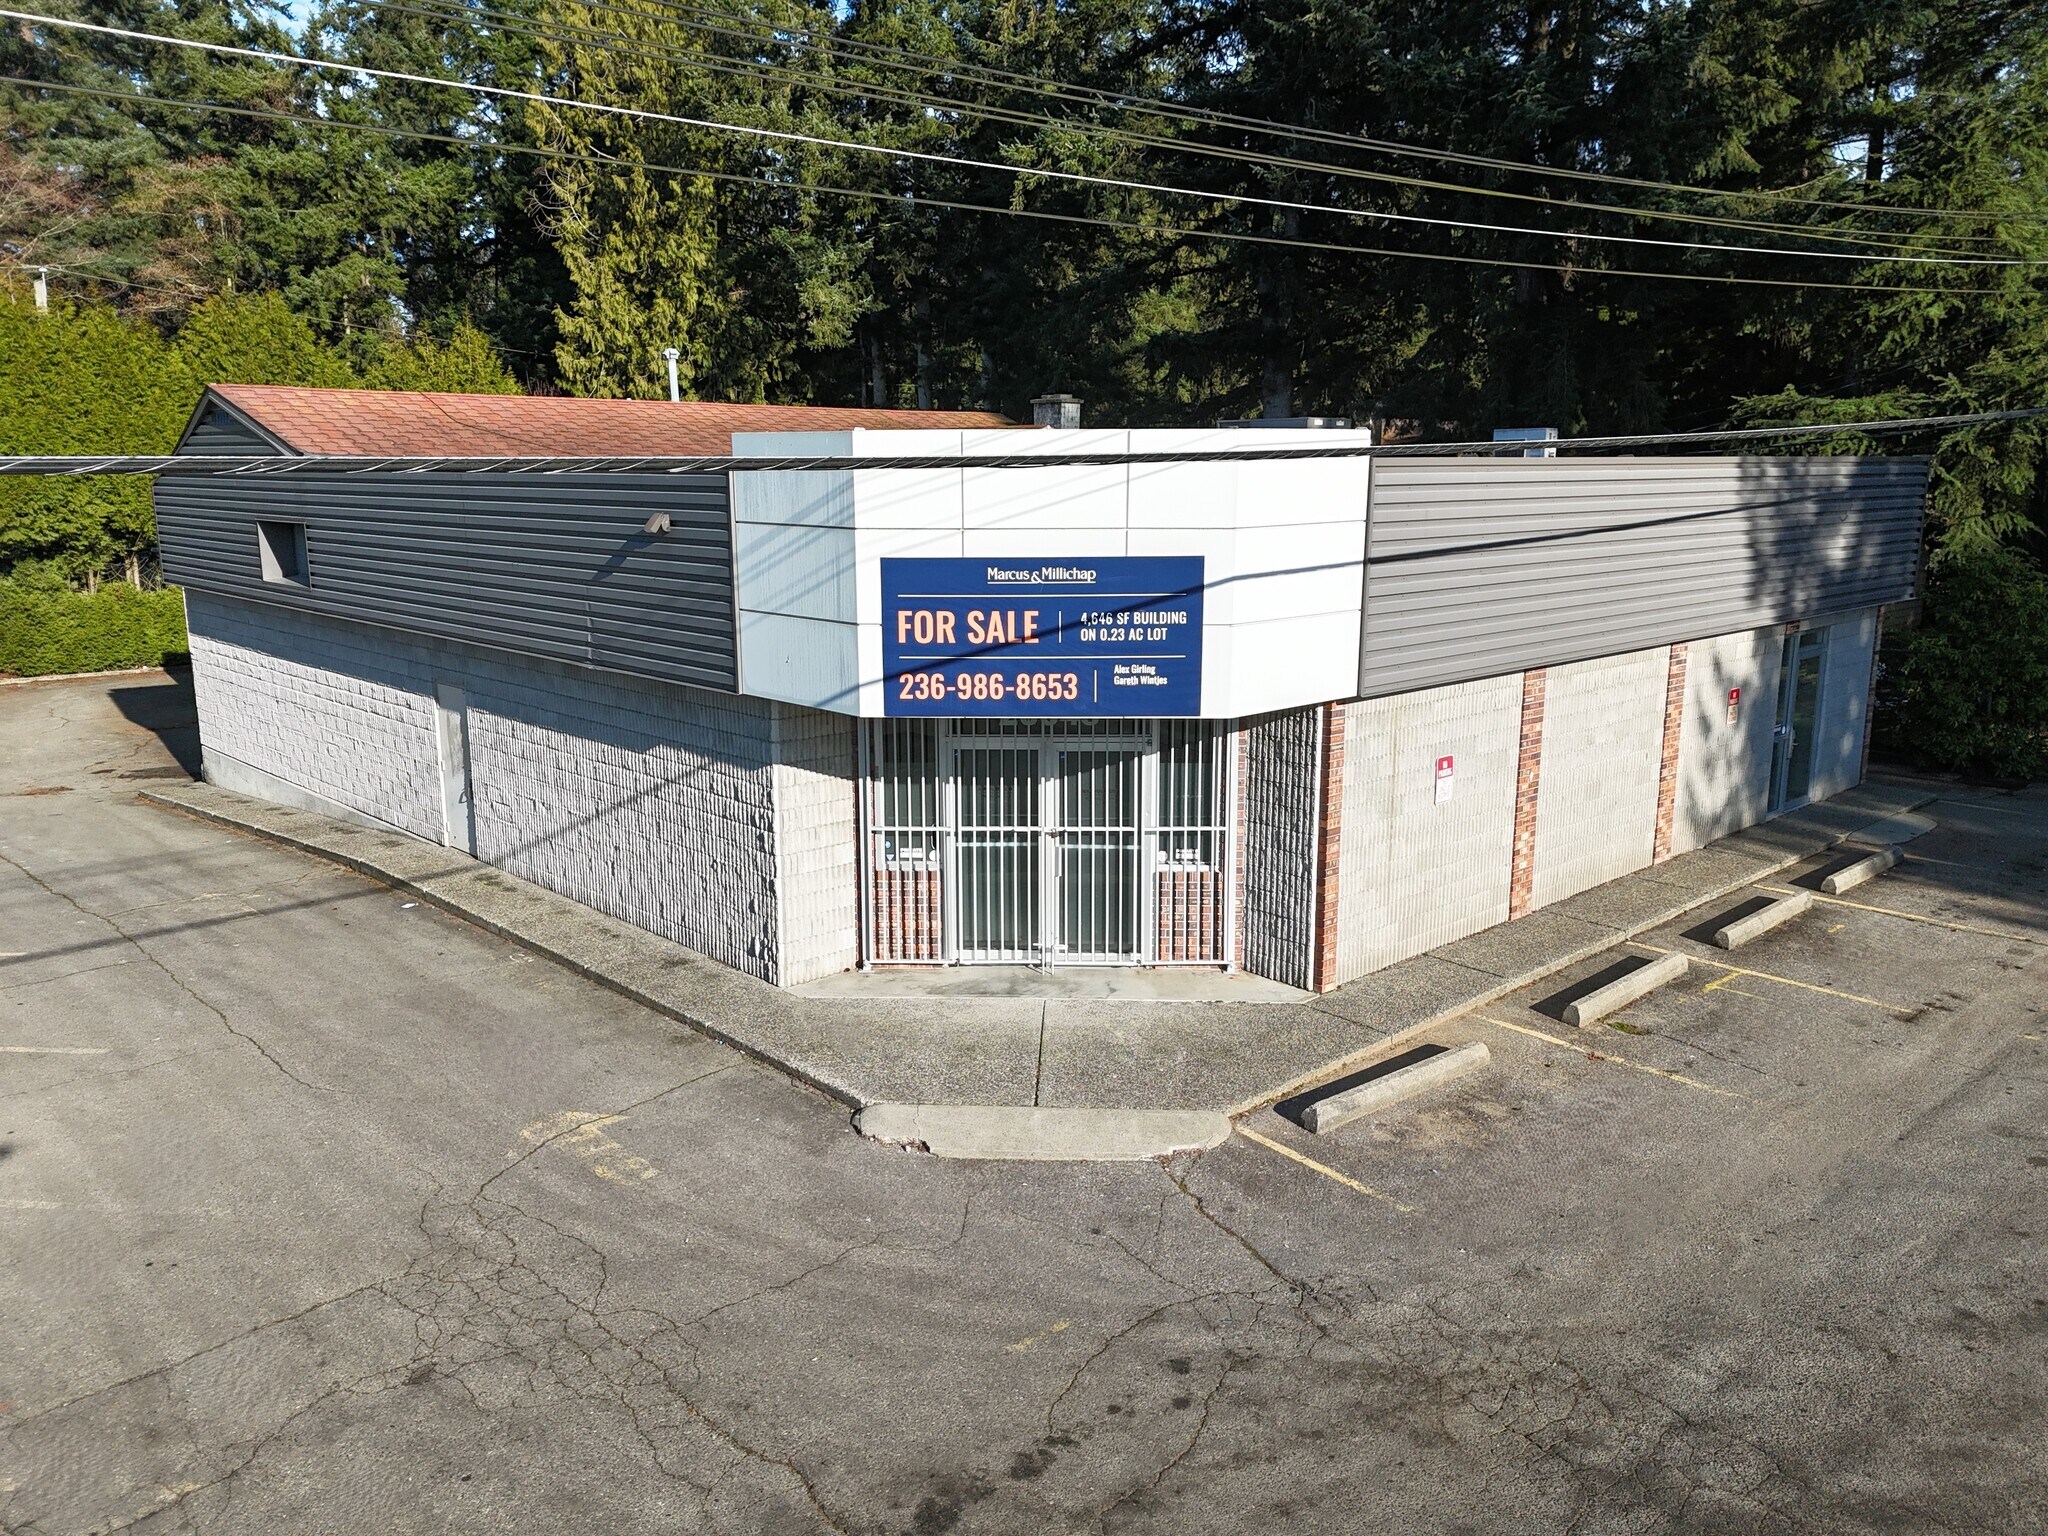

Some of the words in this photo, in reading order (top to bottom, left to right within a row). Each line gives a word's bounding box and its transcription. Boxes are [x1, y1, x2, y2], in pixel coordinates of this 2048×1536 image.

[987, 567, 1030, 580] Marcus
[1041, 567, 1097, 583] Millichap
[897, 610, 956, 644] FOR
[966, 610, 1039, 644] SALE
[1080, 611, 1113, 627] 4,646
[1116, 611, 1130, 625] SF
[1133, 611, 1187, 625] BUILDING
[1080, 628, 1096, 641] ON
[1100, 628, 1125, 641] 0.23
[1128, 628, 1144, 641] AC
[1147, 627, 1168, 641] LOT
[1114, 665, 1130, 674] Alex
[1131, 664, 1156, 675] Girling
[898, 672, 1078, 701] 236-986-8653
[1114, 676, 1139, 686] Gareth
